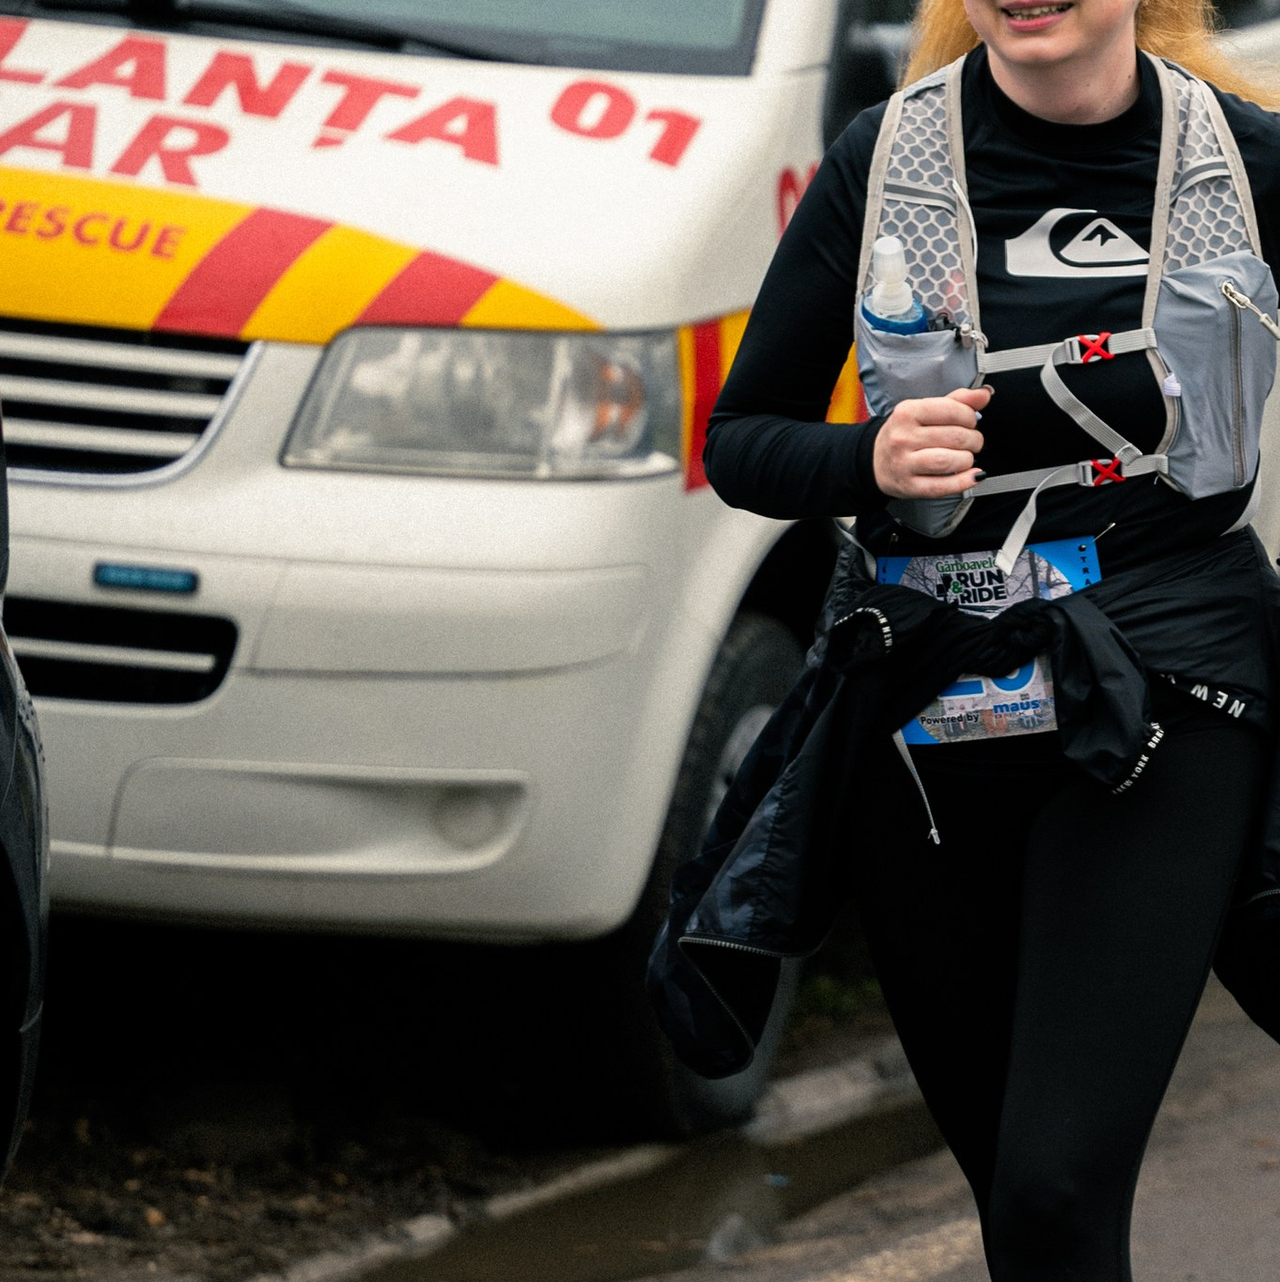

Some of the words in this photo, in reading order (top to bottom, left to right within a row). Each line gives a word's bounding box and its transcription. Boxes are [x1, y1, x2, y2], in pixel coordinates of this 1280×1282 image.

[549, 80, 703, 169] 01
[0, 101, 230, 188] AR
[0, 199, 187, 261] ESCUE
[957, 569, 1004, 589] RUN
[960, 585, 1007, 604] RIDE
[993, 699, 1040, 713] maus
[1190, 683, 1246, 718] NEW
[920, 714, 963, 725] Powered
[966, 713, 979, 722] by
[1130, 754, 1150, 779] YORK
